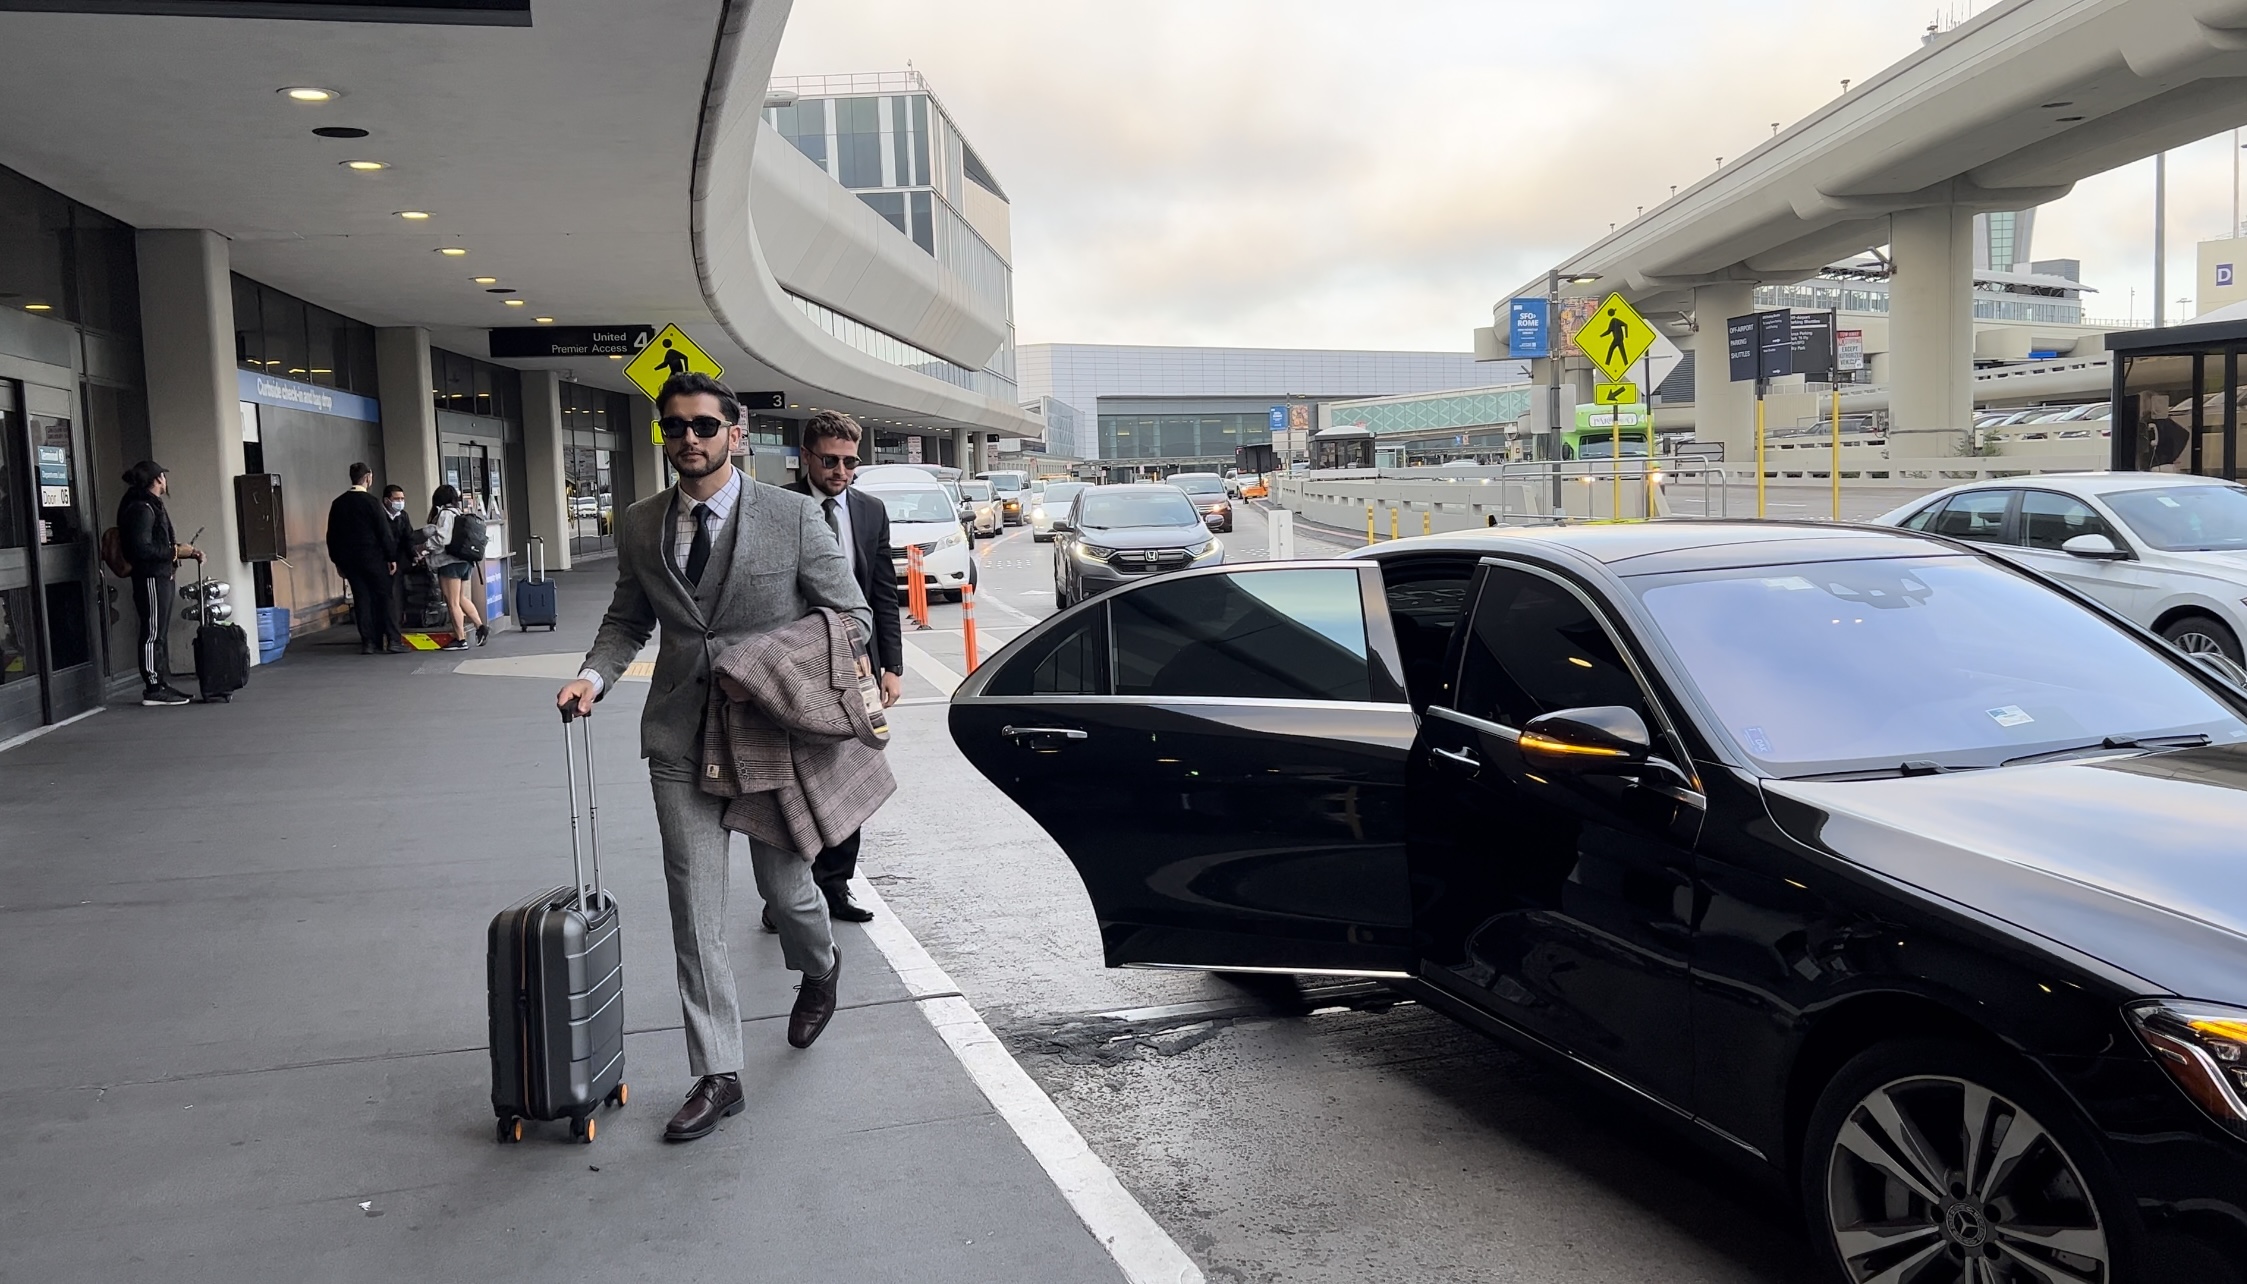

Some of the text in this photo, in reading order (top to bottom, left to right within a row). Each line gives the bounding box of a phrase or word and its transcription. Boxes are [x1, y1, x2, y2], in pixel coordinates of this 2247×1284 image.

[2218, 268, 2231, 282] D
[1517, 319, 1539, 327] ROME
[1730, 324, 1754, 334] OFF-AIRPORT
[593, 331, 648, 348] United 4
[1730, 338, 1747, 346] PARKING
[552, 343, 627, 353] Premier Access
[1731, 350, 1750, 359] SHUTTLES
[257, 377, 282, 399] Curbside
[282, 383, 304, 402] check-in
[322, 392, 333, 411] drop
[772, 394, 782, 407] 3
[43, 489, 68, 504] Door 05
